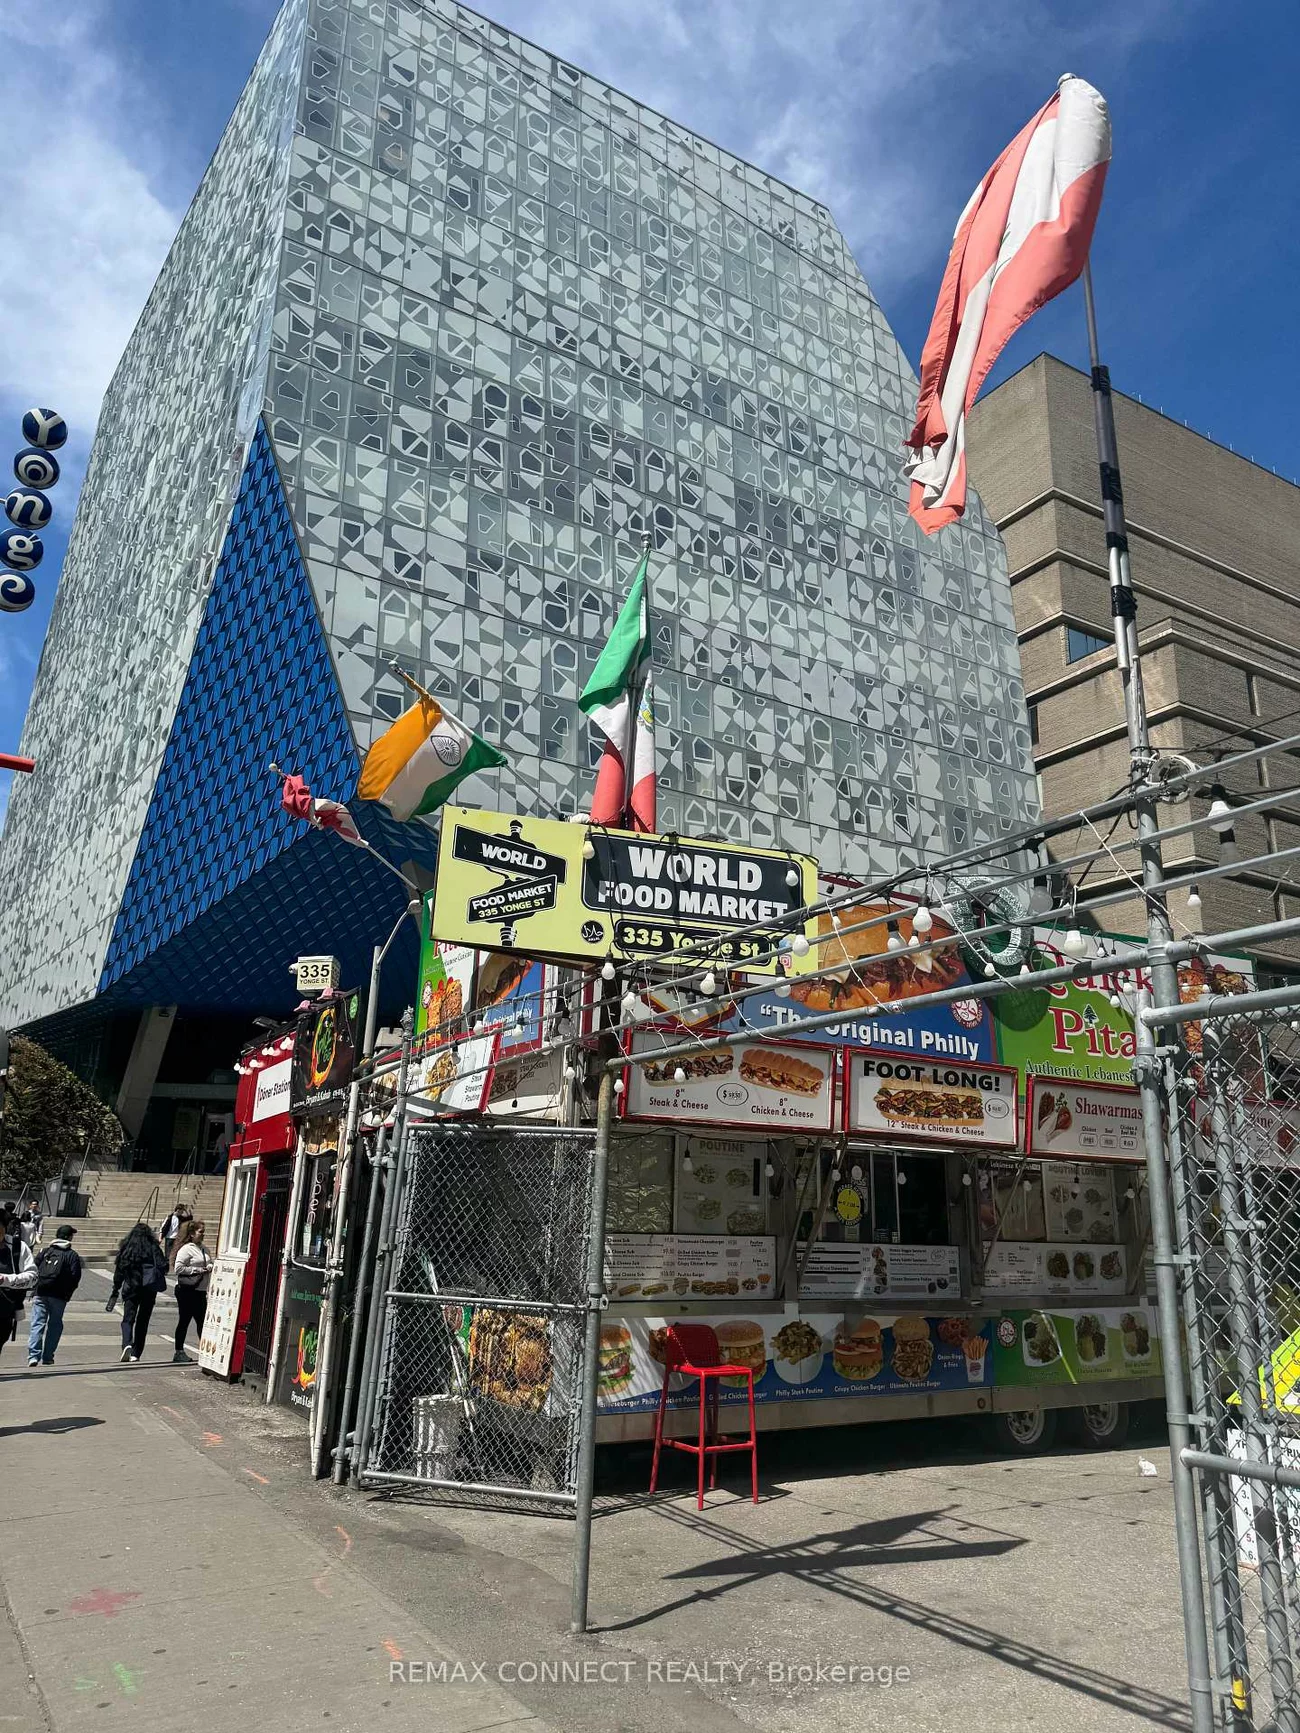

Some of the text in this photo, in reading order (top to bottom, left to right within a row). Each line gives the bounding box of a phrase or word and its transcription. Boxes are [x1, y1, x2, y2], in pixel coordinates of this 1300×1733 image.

[481, 843, 547, 870] WORLD
[628, 846, 762, 892] WORLD
[472, 883, 553, 910] FOOD MARKET
[478, 898, 546, 918] 335 YONGE ST
[598, 880, 788, 924] FOOD MARKET
[623, 928, 663, 947] 335
[300, 964, 330, 978] 335
[760, 1004, 815, 1034] “Th
[920, 1029, 979, 1062] Philly
[1047, 1005, 1138, 1060] Pita
[863, 1059, 1001, 1092] FOOT LONG!
[1025, 1058, 1135, 1084] Authentic Lebanese
[649, 1096, 709, 1110] Steak & Cheese
[751, 1105, 814, 1119] Chicken & Cheese
[1074, 1096, 1143, 1121] Shawarmas
[901, 1120, 919, 1130] Steak
[928, 1123, 953, 1133] Chicken
[961, 1126, 985, 1136] Cheese
[699, 1140, 745, 1153] POUTINE
